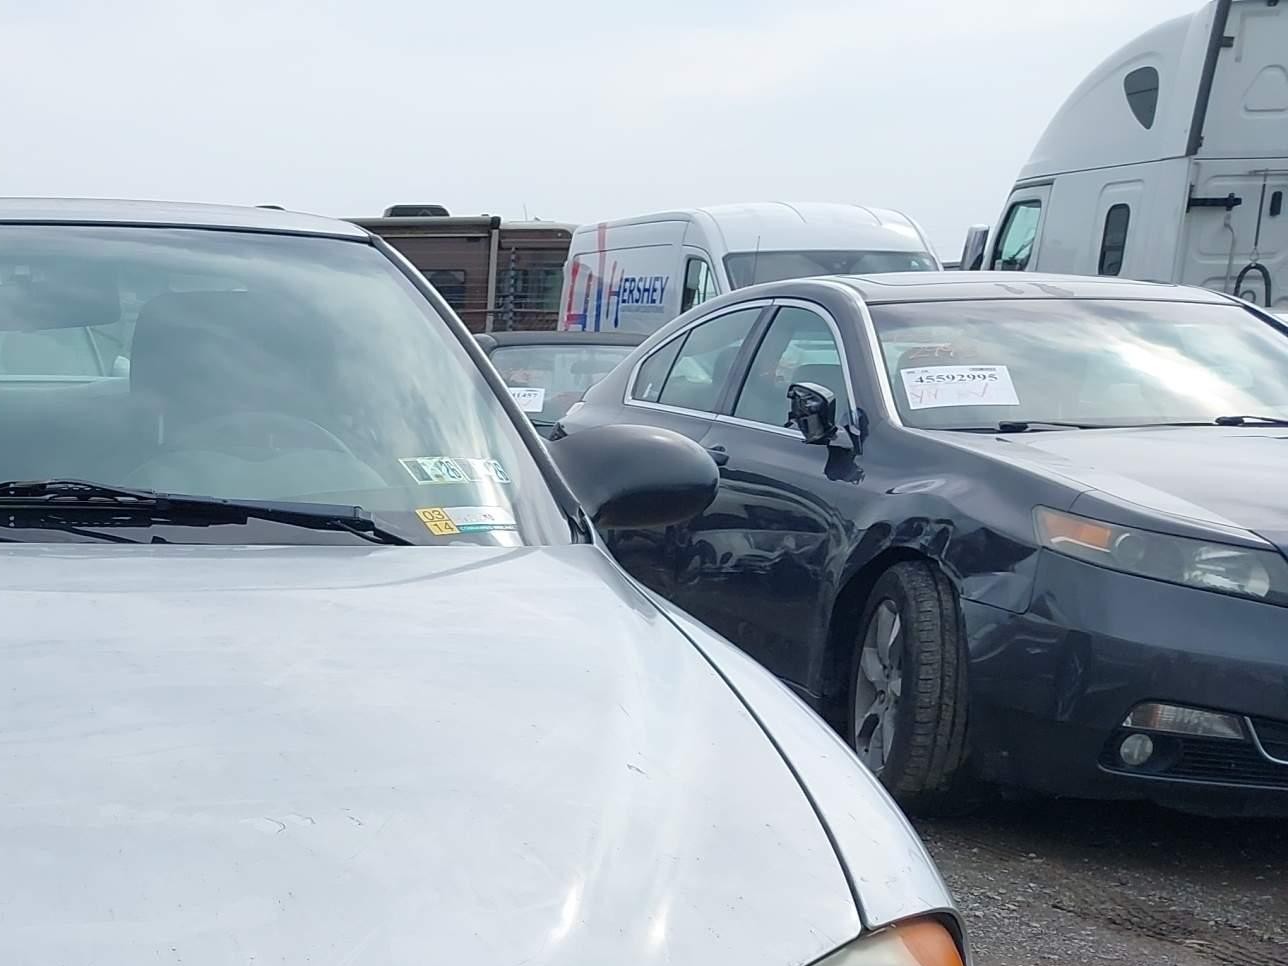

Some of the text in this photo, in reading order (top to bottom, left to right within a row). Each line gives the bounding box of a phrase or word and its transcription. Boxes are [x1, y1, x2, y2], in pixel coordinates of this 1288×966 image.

[606, 260, 670, 329] HERSHEY
[915, 374, 998, 383] 45592995
[422, 509, 445, 521] 03
[433, 522, 454, 533] 14
